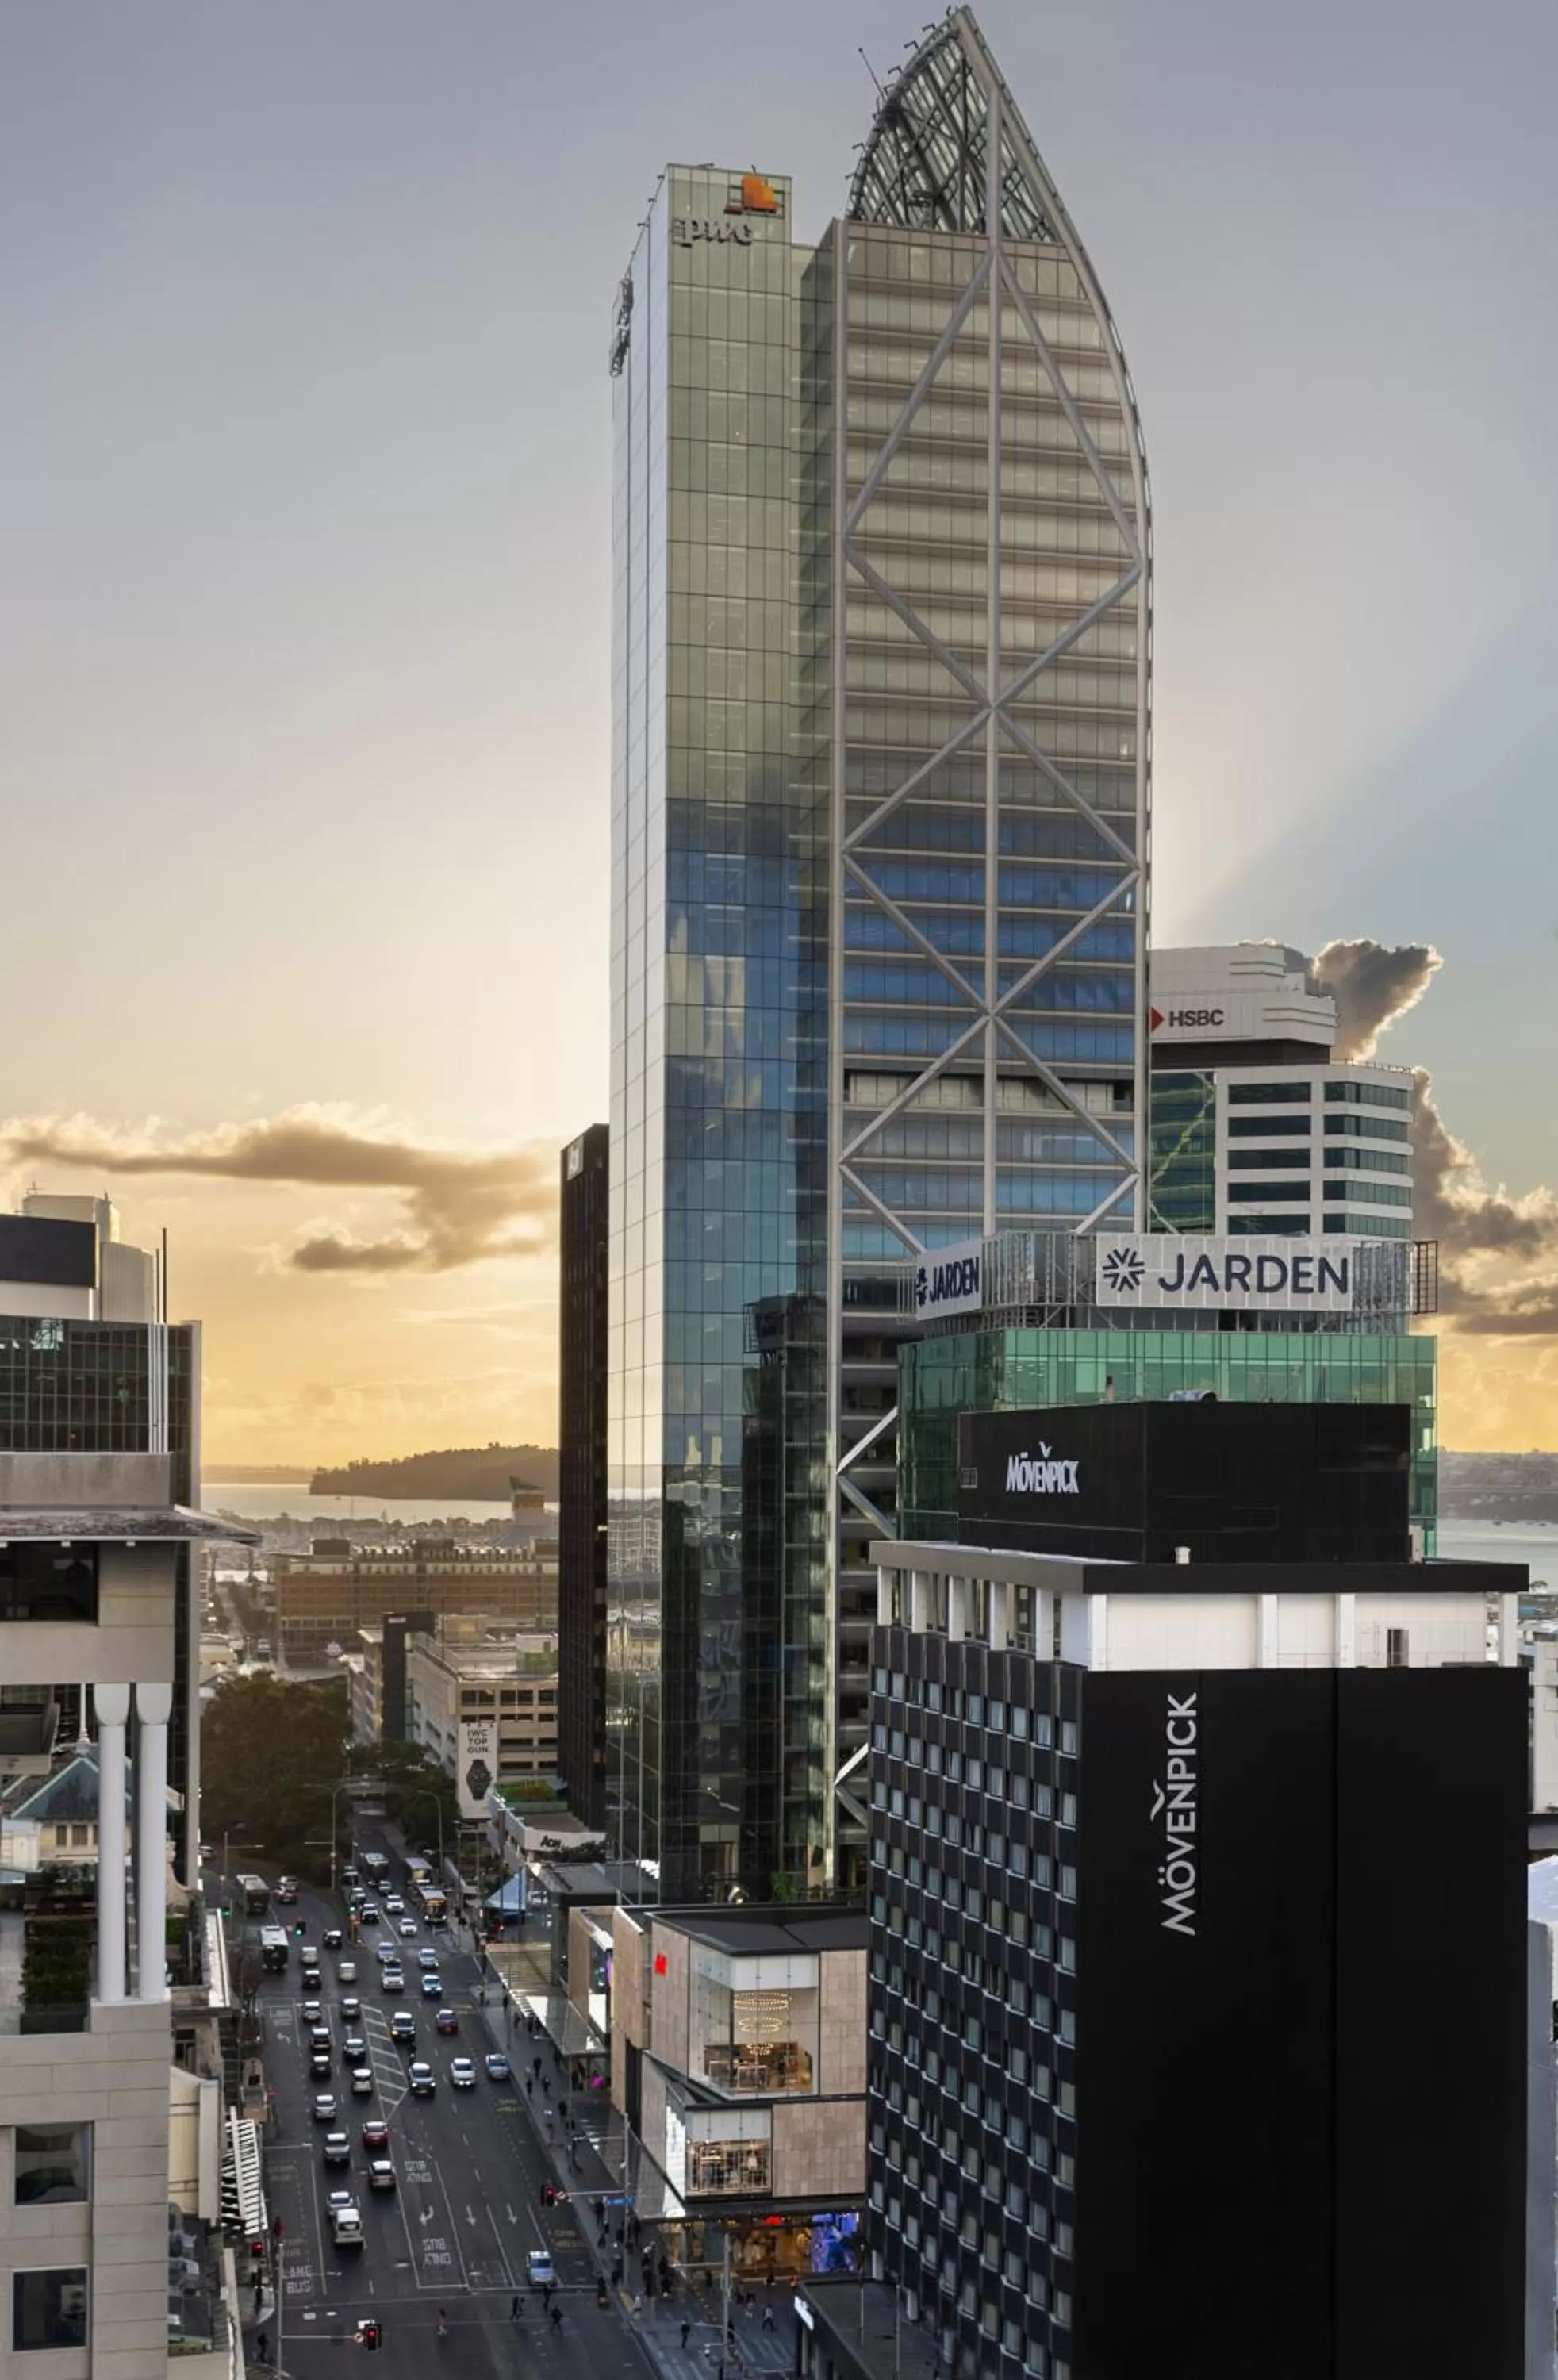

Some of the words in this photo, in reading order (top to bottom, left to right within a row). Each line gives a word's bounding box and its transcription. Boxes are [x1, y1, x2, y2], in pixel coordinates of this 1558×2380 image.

[1168, 1009, 1224, 1027] HSBC
[930, 1257, 980, 1302] JARDEN
[1158, 1254, 1349, 1294] JARDEN
